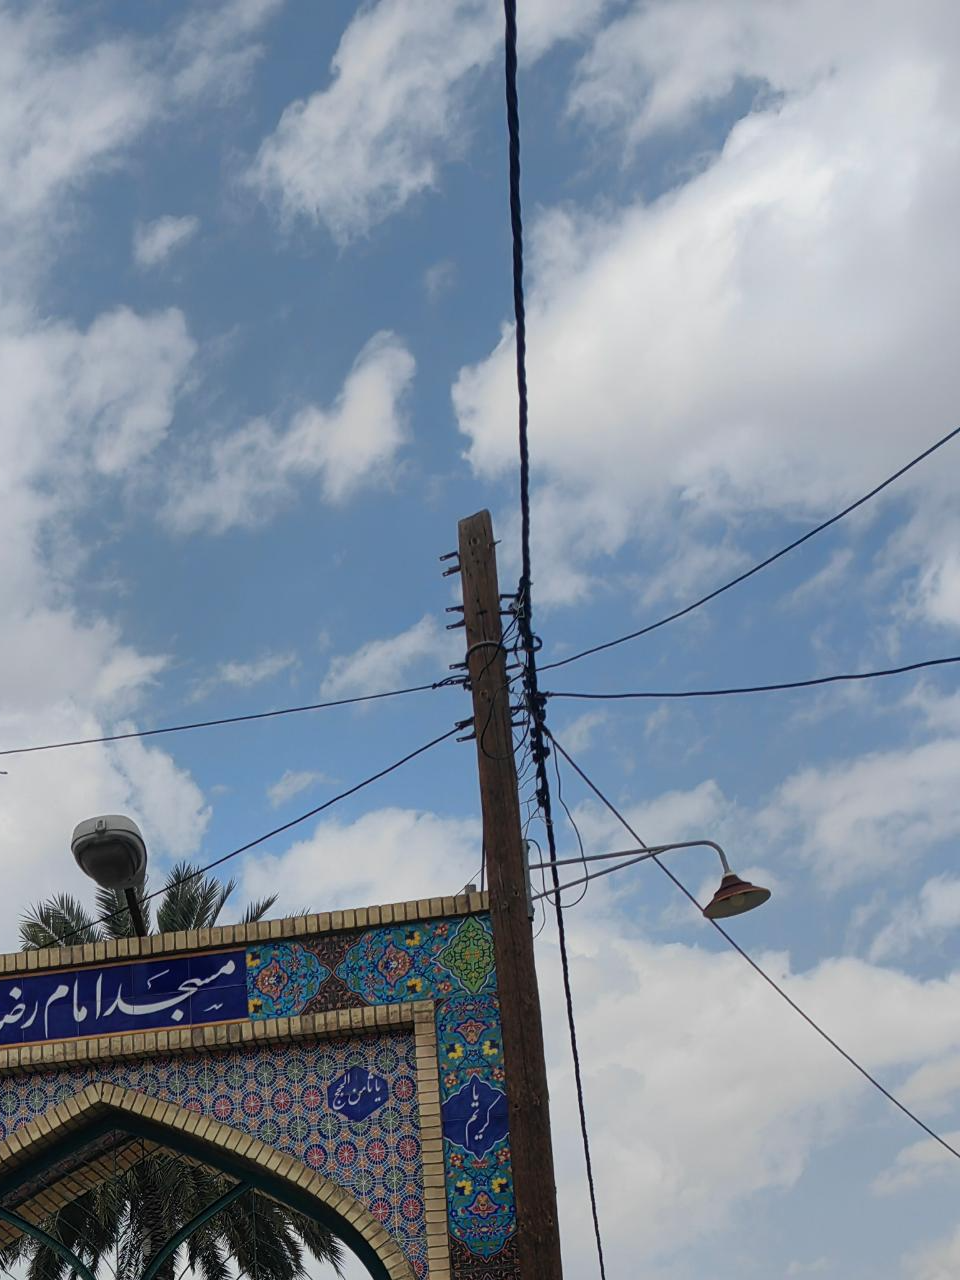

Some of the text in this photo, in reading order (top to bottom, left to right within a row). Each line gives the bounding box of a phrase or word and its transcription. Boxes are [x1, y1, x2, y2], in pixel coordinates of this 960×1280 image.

[44, 972, 103, 1039] امام
[102, 958, 236, 1022] مسجد
[347, 1070, 374, 1106] ثامن
[374, 1078, 382, 1102] یا
[471, 1083, 480, 1107] یا
[465, 1094, 502, 1147] کریم
